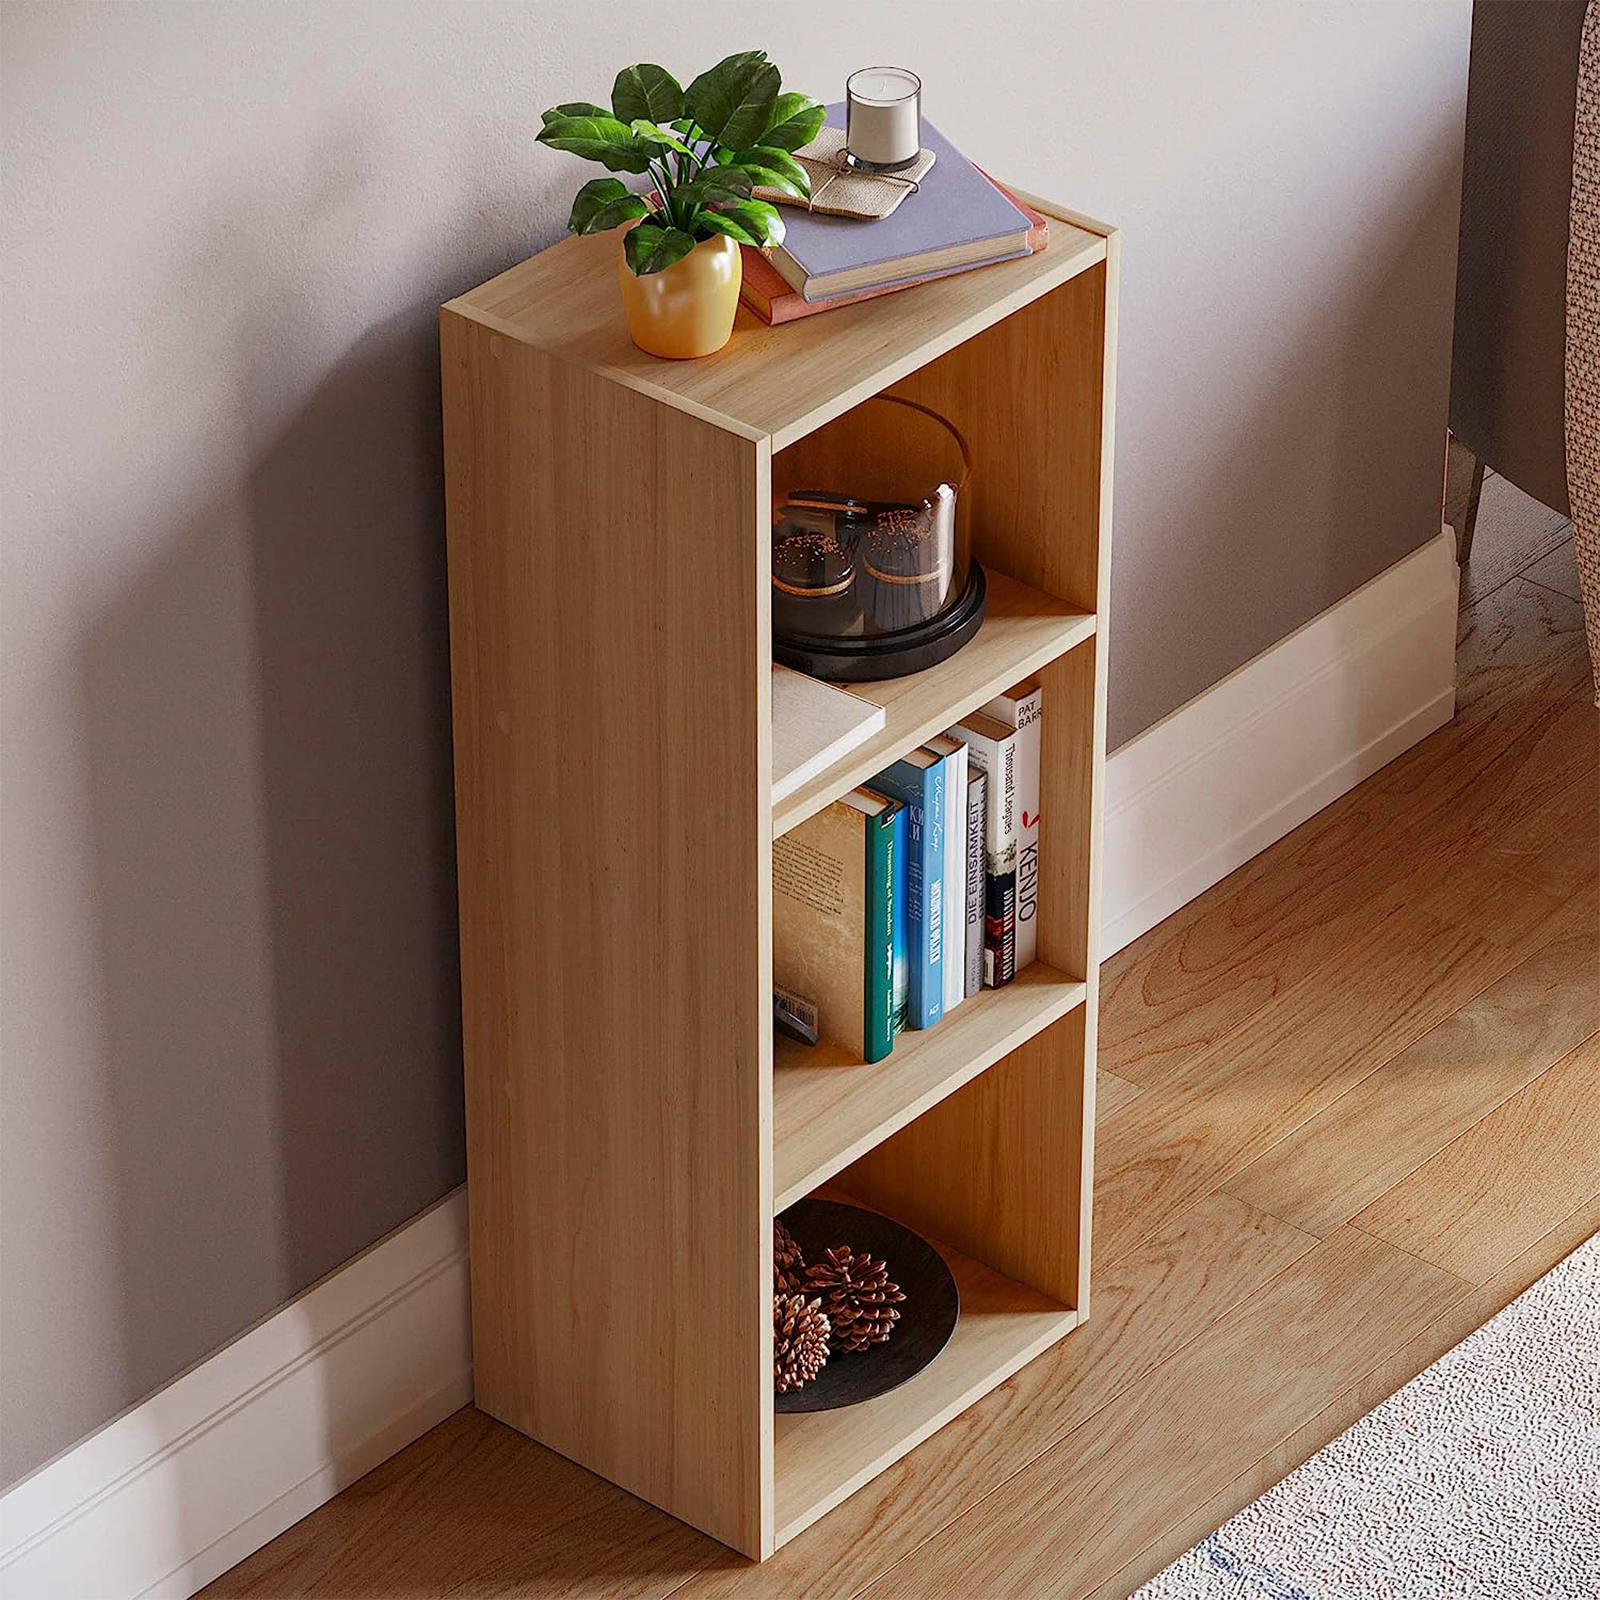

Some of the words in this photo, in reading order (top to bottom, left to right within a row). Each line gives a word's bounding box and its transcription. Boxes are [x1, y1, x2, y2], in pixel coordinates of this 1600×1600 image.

[1018, 701, 1036, 716] PAT
[1005, 743, 1016, 792] Thousand
[1002, 792, 1015, 835] Leagues
[886, 840, 894, 888] Dreaming
[969, 802, 979, 892] EINSAMKEIT
[1018, 841, 1038, 922] KENJO
[968, 900, 978, 925] DIE
